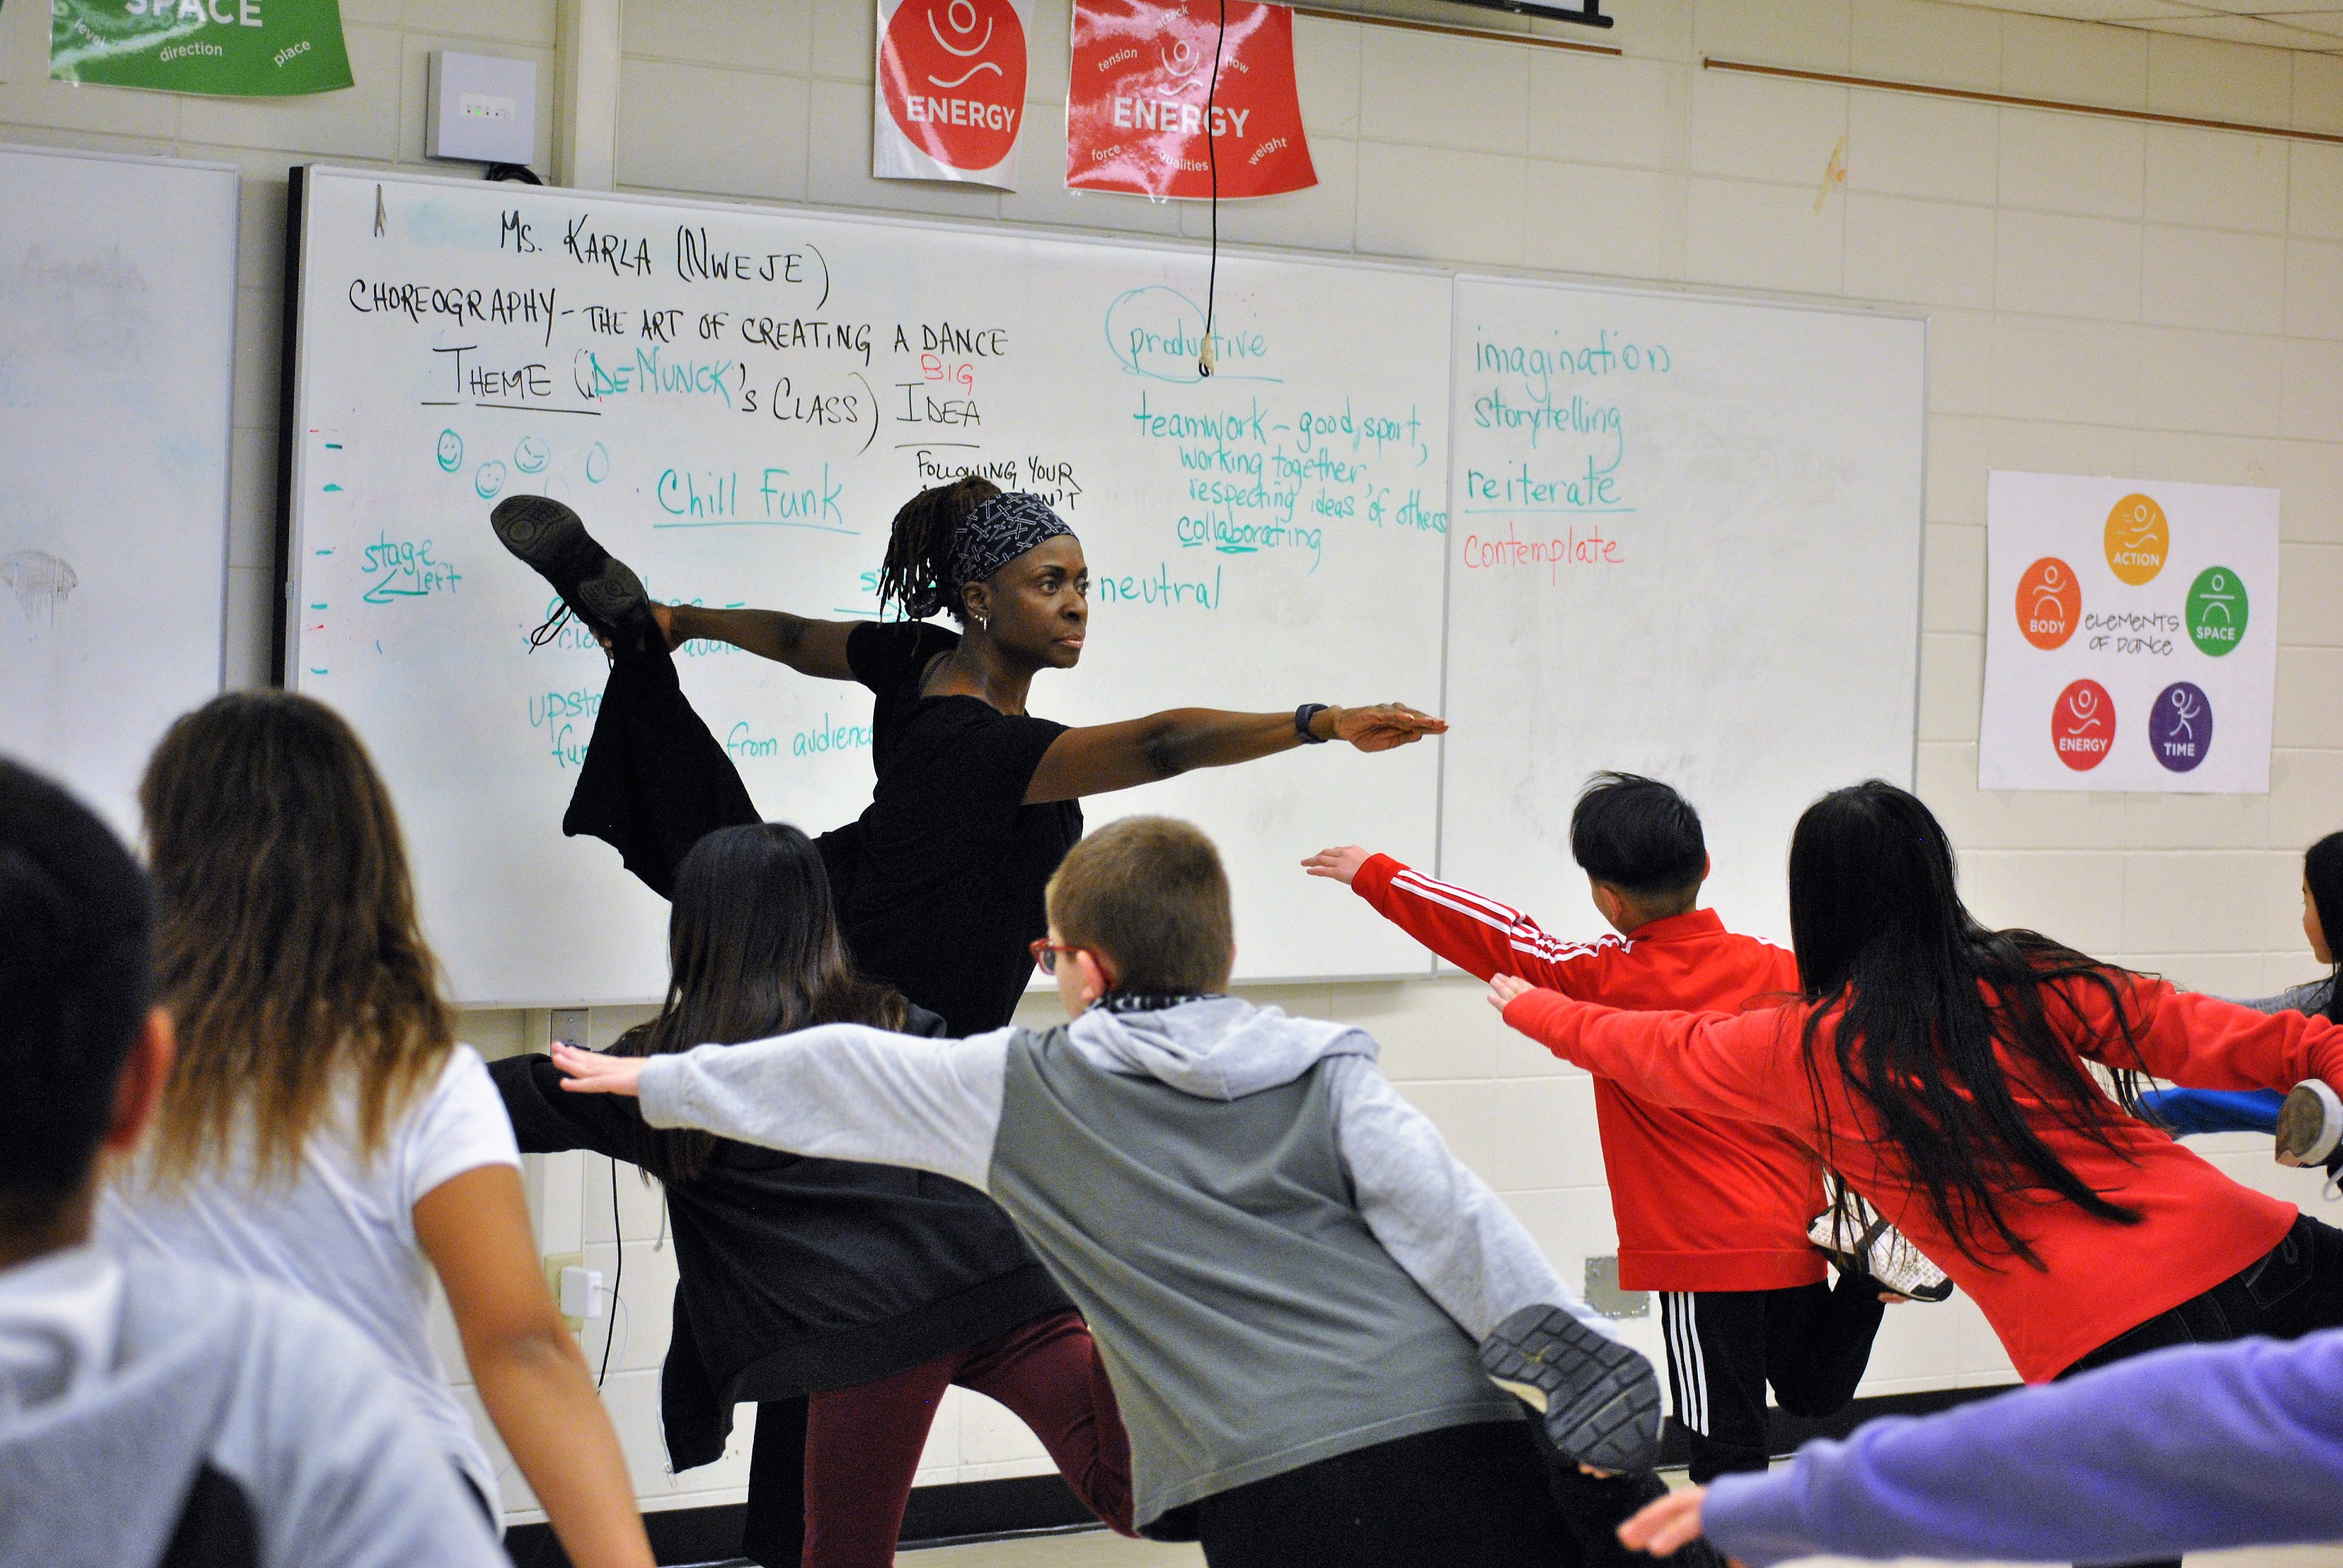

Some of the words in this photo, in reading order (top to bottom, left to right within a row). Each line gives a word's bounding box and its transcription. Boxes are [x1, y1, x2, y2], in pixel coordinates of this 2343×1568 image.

[1156, 4, 1188, 29] attack
[160, 42, 223, 61] direction
[274, 39, 311, 67] place
[1098, 47, 1138, 72] tension
[907, 95, 1016, 133] ENERGY
[1114, 96, 1250, 139] ENERGY
[1091, 144, 1121, 162] force
[1159, 150, 1209, 172] qualities
[1248, 137, 1288, 166] weight
[564, 214, 652, 276] KARLA
[677, 224, 830, 311] (NWEJE)
[583, 305, 628, 335] THE
[641, 310, 684, 343] ART
[699, 313, 729, 340] OF
[742, 316, 872, 367] CREATING
[894, 325, 909, 353] A
[922, 321, 1008, 357] DANCE
[921, 354, 974, 396] BIG
[1476, 325, 1670, 403] imagination
[432, 345, 551, 400] THEME
[773, 371, 879, 456] CLASS)
[895, 383, 980, 427] IDEA
[1133, 390, 1268, 445] teamwork
[916, 450, 1017, 489] FOLLOWING
[1028, 456, 1082, 492] YOUR
[1179, 443, 1263, 489] working
[1468, 455, 1621, 505] reiterate
[658, 469, 736, 518] Chill
[759, 462, 844, 524] Funk
[1189, 479, 1296, 523] respecting
[1311, 487, 1355, 518] ideas
[1368, 488, 1390, 528] of
[362, 529, 436, 575] stage
[1178, 509, 1322, 575] collaborating
[2113, 552, 2160, 567] ACTION
[416, 562, 462, 593] left
[1100, 561, 1222, 610] neutral
[2029, 620, 2065, 634] BODY
[2196, 626, 2235, 641] SPACE
[727, 721, 778, 765] from
[2059, 737, 2108, 753] ENERGY
[2163, 742, 2195, 757] TIME
